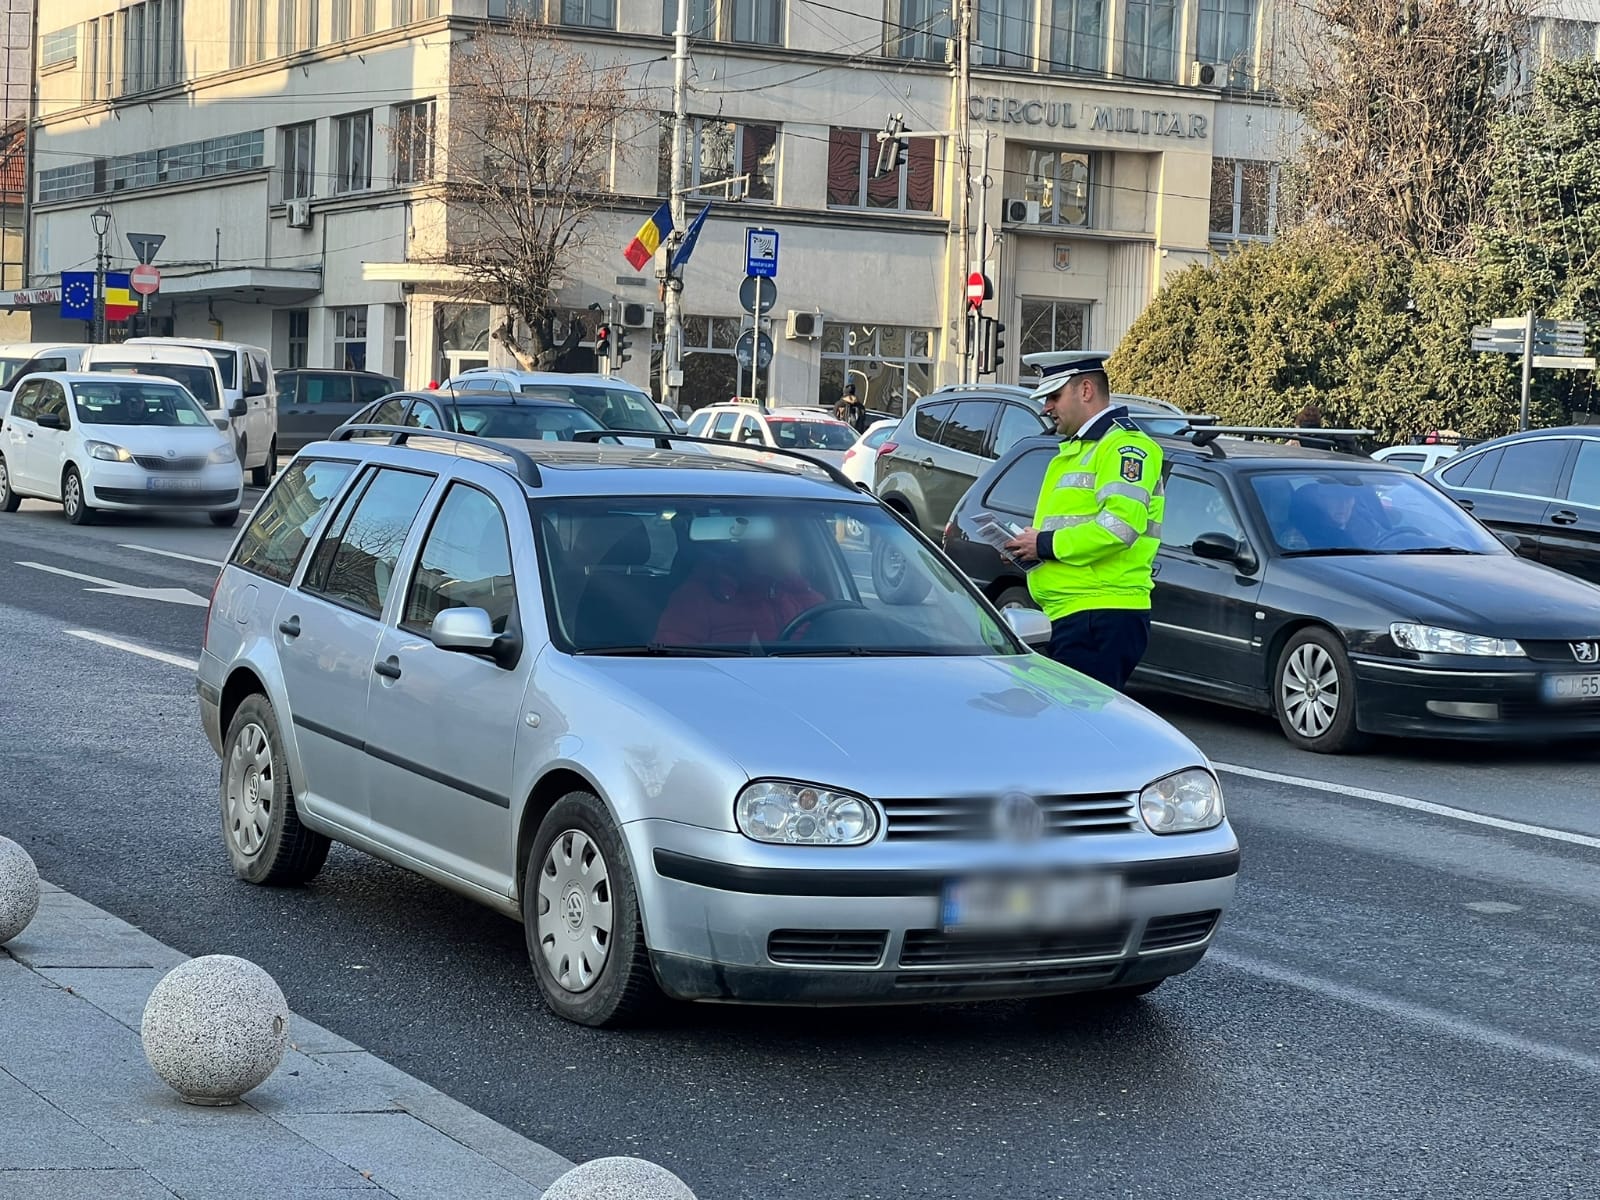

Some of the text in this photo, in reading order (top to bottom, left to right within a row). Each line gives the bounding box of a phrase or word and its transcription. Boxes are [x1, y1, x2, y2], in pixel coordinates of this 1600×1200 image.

[968, 95, 1207, 139] CERCUL MILITAR
[739, 397, 758, 405] TAXI
[1582, 676, 1599, 695] 55
